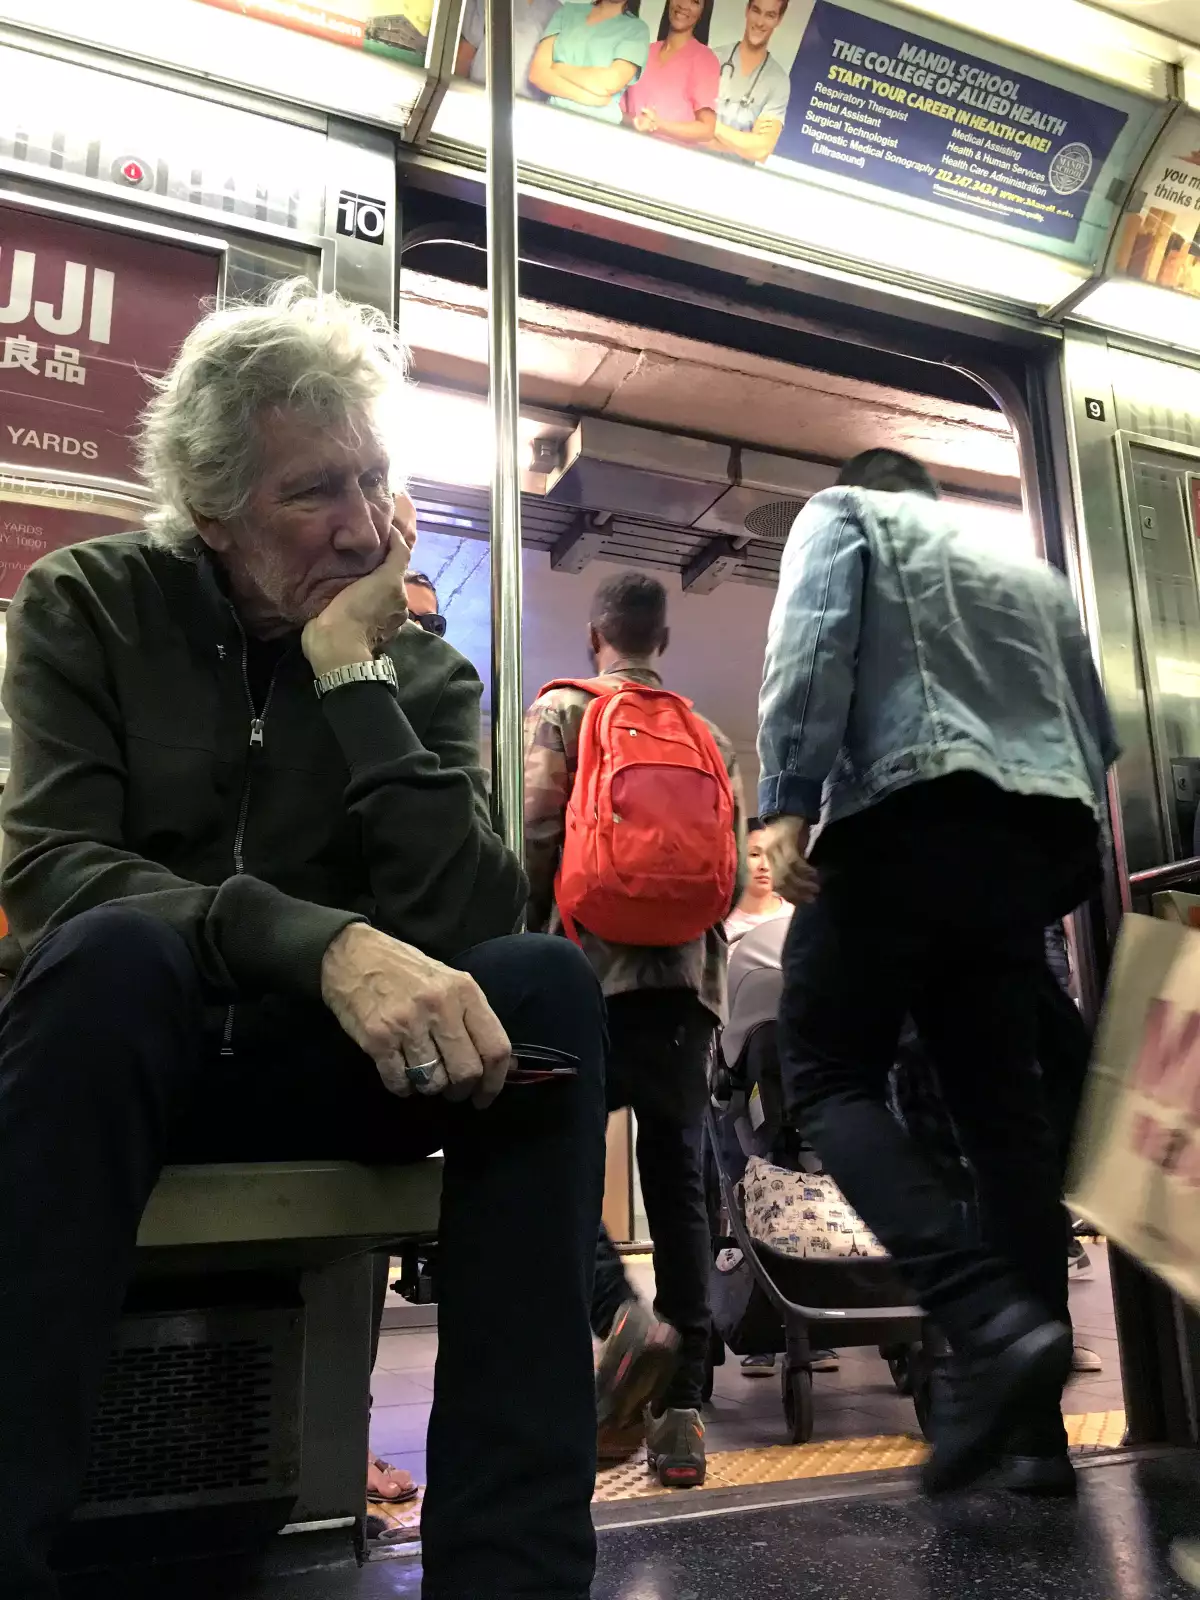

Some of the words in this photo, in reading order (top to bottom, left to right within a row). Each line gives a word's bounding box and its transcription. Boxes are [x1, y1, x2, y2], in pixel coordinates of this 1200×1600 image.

[831, 38, 866, 65] THE
[864, 52, 938, 91] COLLEGE
[935, 76, 962, 98] OF
[957, 86, 1012, 116] ALLIED
[1009, 103, 1069, 137] HEALTH
[897, 42, 957, 79] MANDL
[957, 64, 1021, 101] SCHOOL
[809, 96, 840, 114] Dental
[840, 107, 882, 128] Assistant
[814, 82, 867, 109] Respiratory
[868, 99, 909, 122] Therapist
[827, 65, 871, 91] START
[871, 80, 908, 104] YOUR
[906, 92, 957, 121] CAREER
[954, 109, 970, 126] IN
[805, 110, 843, 131] Surgical
[843, 122, 899, 149] Technologist
[951, 127, 984, 147] Medical
[983, 140, 1022, 162] Assisting
[801, 124, 848, 148] Diagnostic
[849, 140, 885, 159] Medical
[884, 151, 937, 177] Sonography
[811, 142, 866, 169] (Ultrasound)
[946, 141, 974, 158] Health
[974, 151, 982, 161] &
[982, 153, 1011, 171] Human
[1011, 162, 1046, 182] Services
[942, 154, 969, 171] Health
[969, 163, 989, 178] Care
[989, 170, 1047, 197] Administration
[1160, 167, 1189, 184] you
[1153, 183, 1193, 208] thinks
[338, 199, 385, 238] 10
[1089, 401, 1101, 417] 9
[6, 425, 99, 459] YARDS
[3, 521, 44, 536] YARDS
[15, 535, 47, 549] 10001
